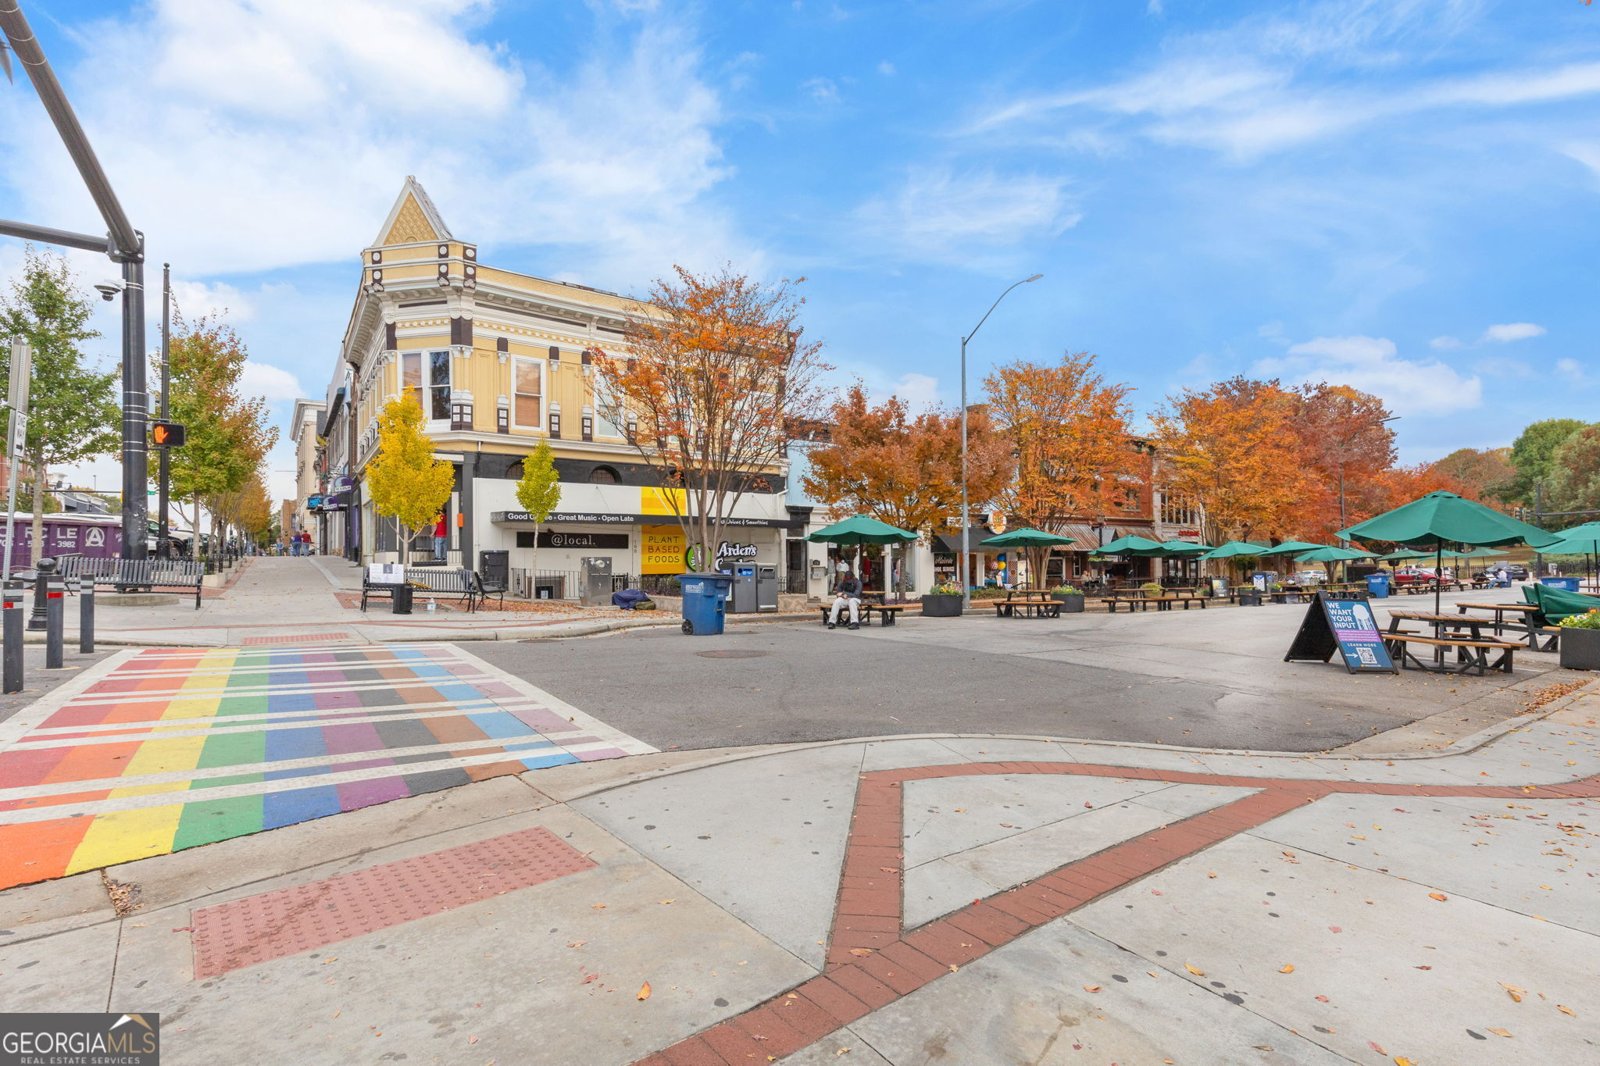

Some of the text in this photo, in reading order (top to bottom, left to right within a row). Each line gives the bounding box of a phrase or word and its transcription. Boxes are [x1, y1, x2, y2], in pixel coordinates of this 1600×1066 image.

[507, 512, 528, 520] Good
[551, 534, 596, 546] @local.
[647, 545, 680, 553] BASED
[716, 542, 757, 557] Arden's
[647, 555, 680, 563] FOODS
